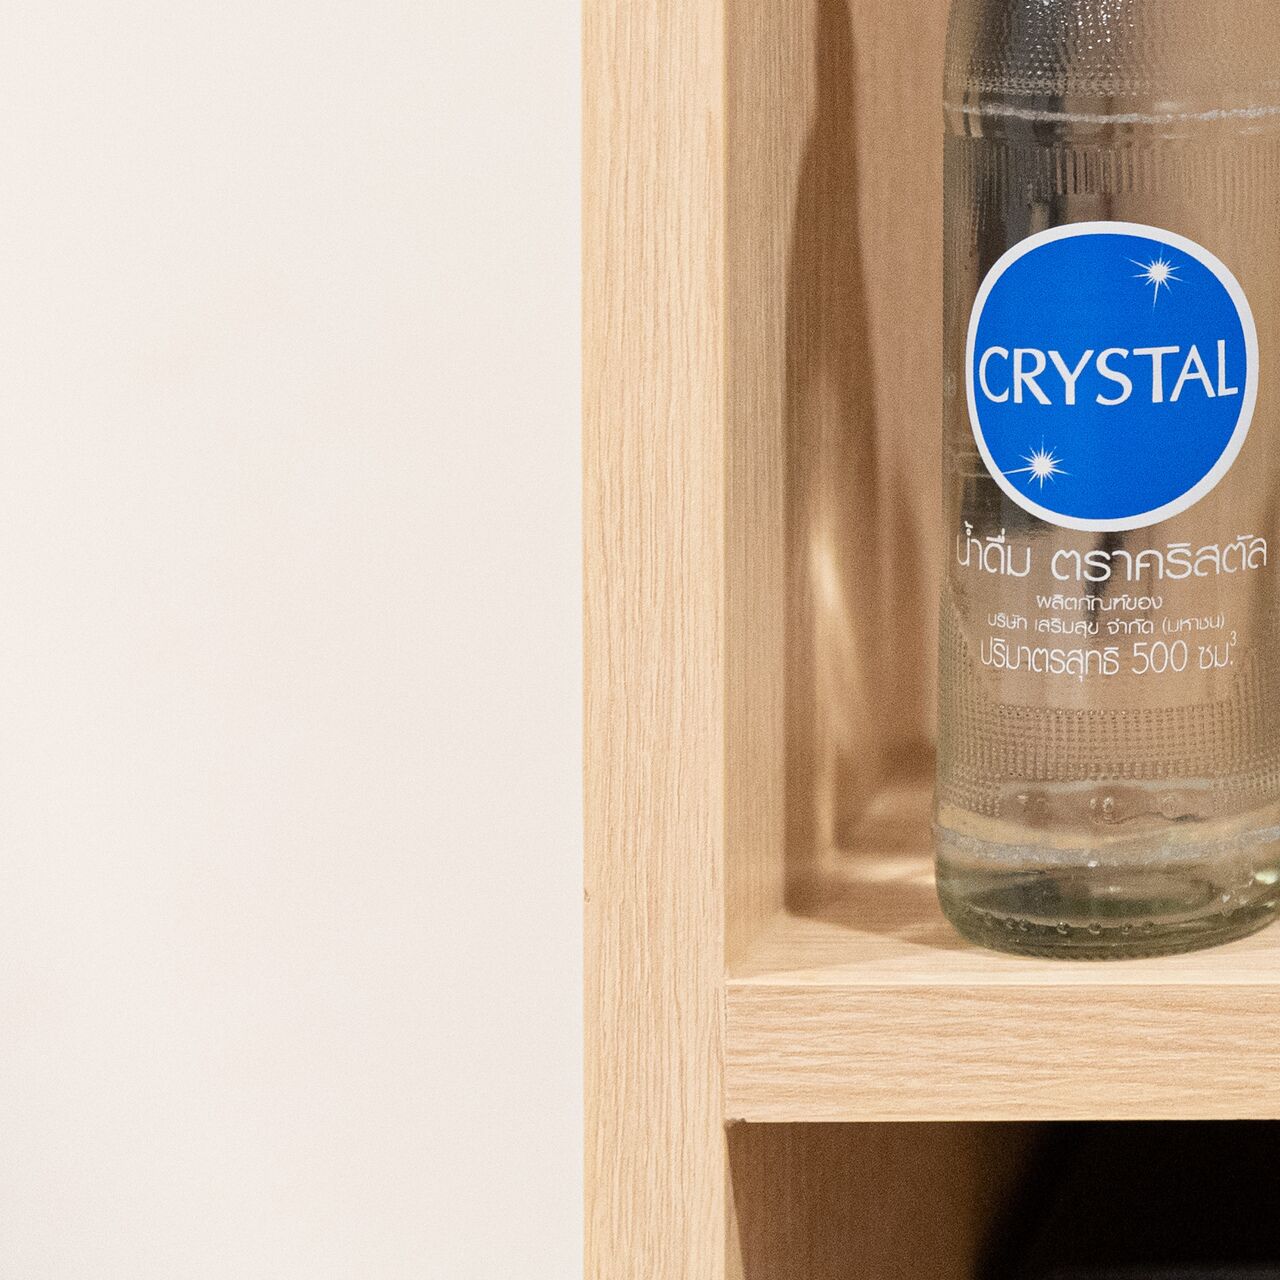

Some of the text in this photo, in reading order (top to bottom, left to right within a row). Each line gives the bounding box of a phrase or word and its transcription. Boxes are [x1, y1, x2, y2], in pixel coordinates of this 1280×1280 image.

[979, 339, 1239, 406] CRYSTAL
[957, 521, 1268, 582] น้ำดื่ม ตราคริสตัล
[1036, 592, 1163, 611] ผลิตภัณฑ์ของ
[988, 613, 1225, 638] บริษัท เสริมสุข จำกัด (มหาชน)
[980, 636, 1119, 682] ปริมาตรสุทธิ
[1132, 639, 1188, 675] 500
